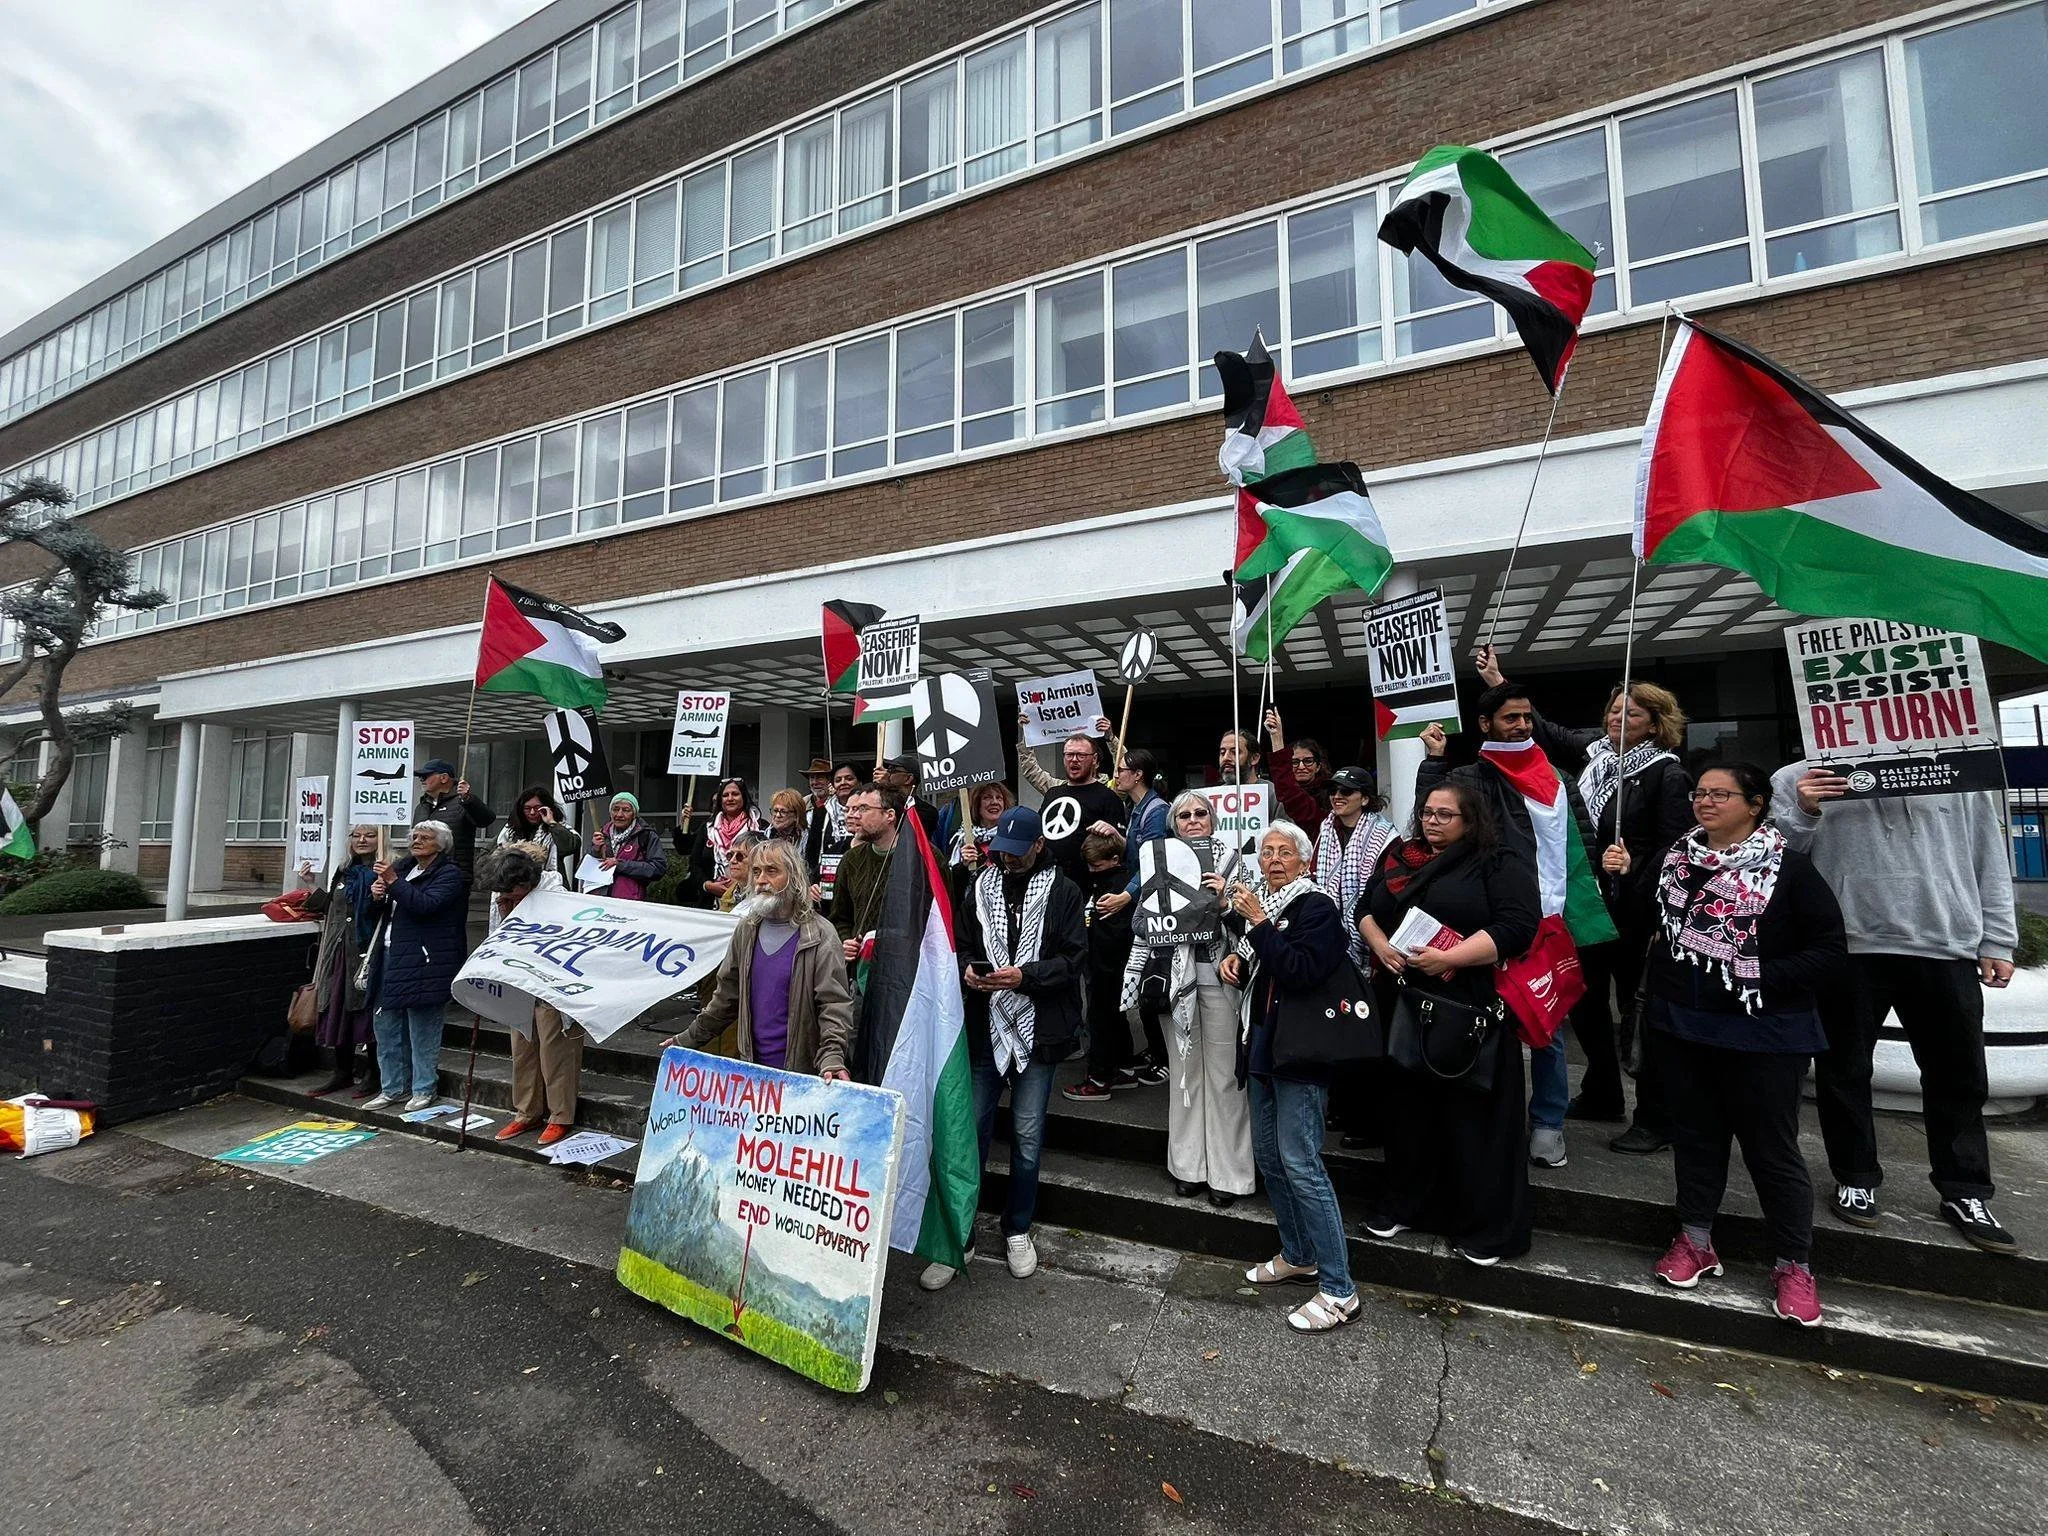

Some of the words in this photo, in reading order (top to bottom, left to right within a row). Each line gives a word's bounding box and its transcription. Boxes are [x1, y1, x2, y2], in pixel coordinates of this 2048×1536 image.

[1367, 604, 1443, 648] CEASEFIRE
[1798, 626, 1846, 655] FREE
[1849, 620, 1947, 648] PALES
[862, 647, 911, 679] NOW!
[1378, 634, 1440, 682] NOW!
[1802, 637, 1966, 683] EXIST!
[1374, 686, 1384, 694] FREE
[1385, 680, 1408, 691] PALESTINE
[1411, 678, 1422, 687] END
[1422, 672, 1452, 685] APARTHEID
[1807, 665, 1970, 704] RESIST!
[682, 696, 726, 711] STOP
[1020, 690, 1046, 705] Stop
[1047, 682, 1095, 701] Arming
[680, 712, 723, 722] ARMING
[1037, 700, 1082, 722] Israel
[1811, 687, 1979, 750] RETURN!
[358, 727, 410, 745] STOP
[357, 747, 409, 759] ARMING
[674, 746, 718, 758] ISRAEL
[922, 757, 956, 780] NO
[1879, 764, 1951, 775] PALESTINE
[1880, 770, 1960, 783] SOLIDARITY
[560, 775, 584, 792] NO
[924, 775, 968, 792] nuclear
[970, 770, 995, 783] war
[1852, 777, 1871, 786] PSC
[1882, 778, 1952, 790] CAMPAIGN
[301, 790, 322, 809] Stop
[355, 790, 407, 804] ISRAEL
[563, 788, 592, 801] nuclear
[592, 786, 607, 795] war
[1208, 792, 1261, 813] TOP
[300, 811, 324, 827] Arming
[1217, 816, 1261, 831] MING
[300, 827, 322, 842] Israel
[1146, 915, 1177, 933] NO
[1149, 931, 1188, 945] nuclear
[1192, 930, 1214, 941] war
[664, 1060, 786, 1115] MOUNTAIN
[650, 1108, 687, 1135] WORLD
[690, 1103, 750, 1130] MILITARY
[754, 1112, 841, 1139] SPENDING
[736, 1132, 870, 1198] MOLEHILL
[735, 1168, 777, 1195] MONEY
[782, 1180, 843, 1221] NEEDED
[843, 1200, 870, 1233] TO
[737, 1199, 771, 1226] END
[775, 1212, 815, 1241] WORLD
[815, 1223, 871, 1263] POVERTY
